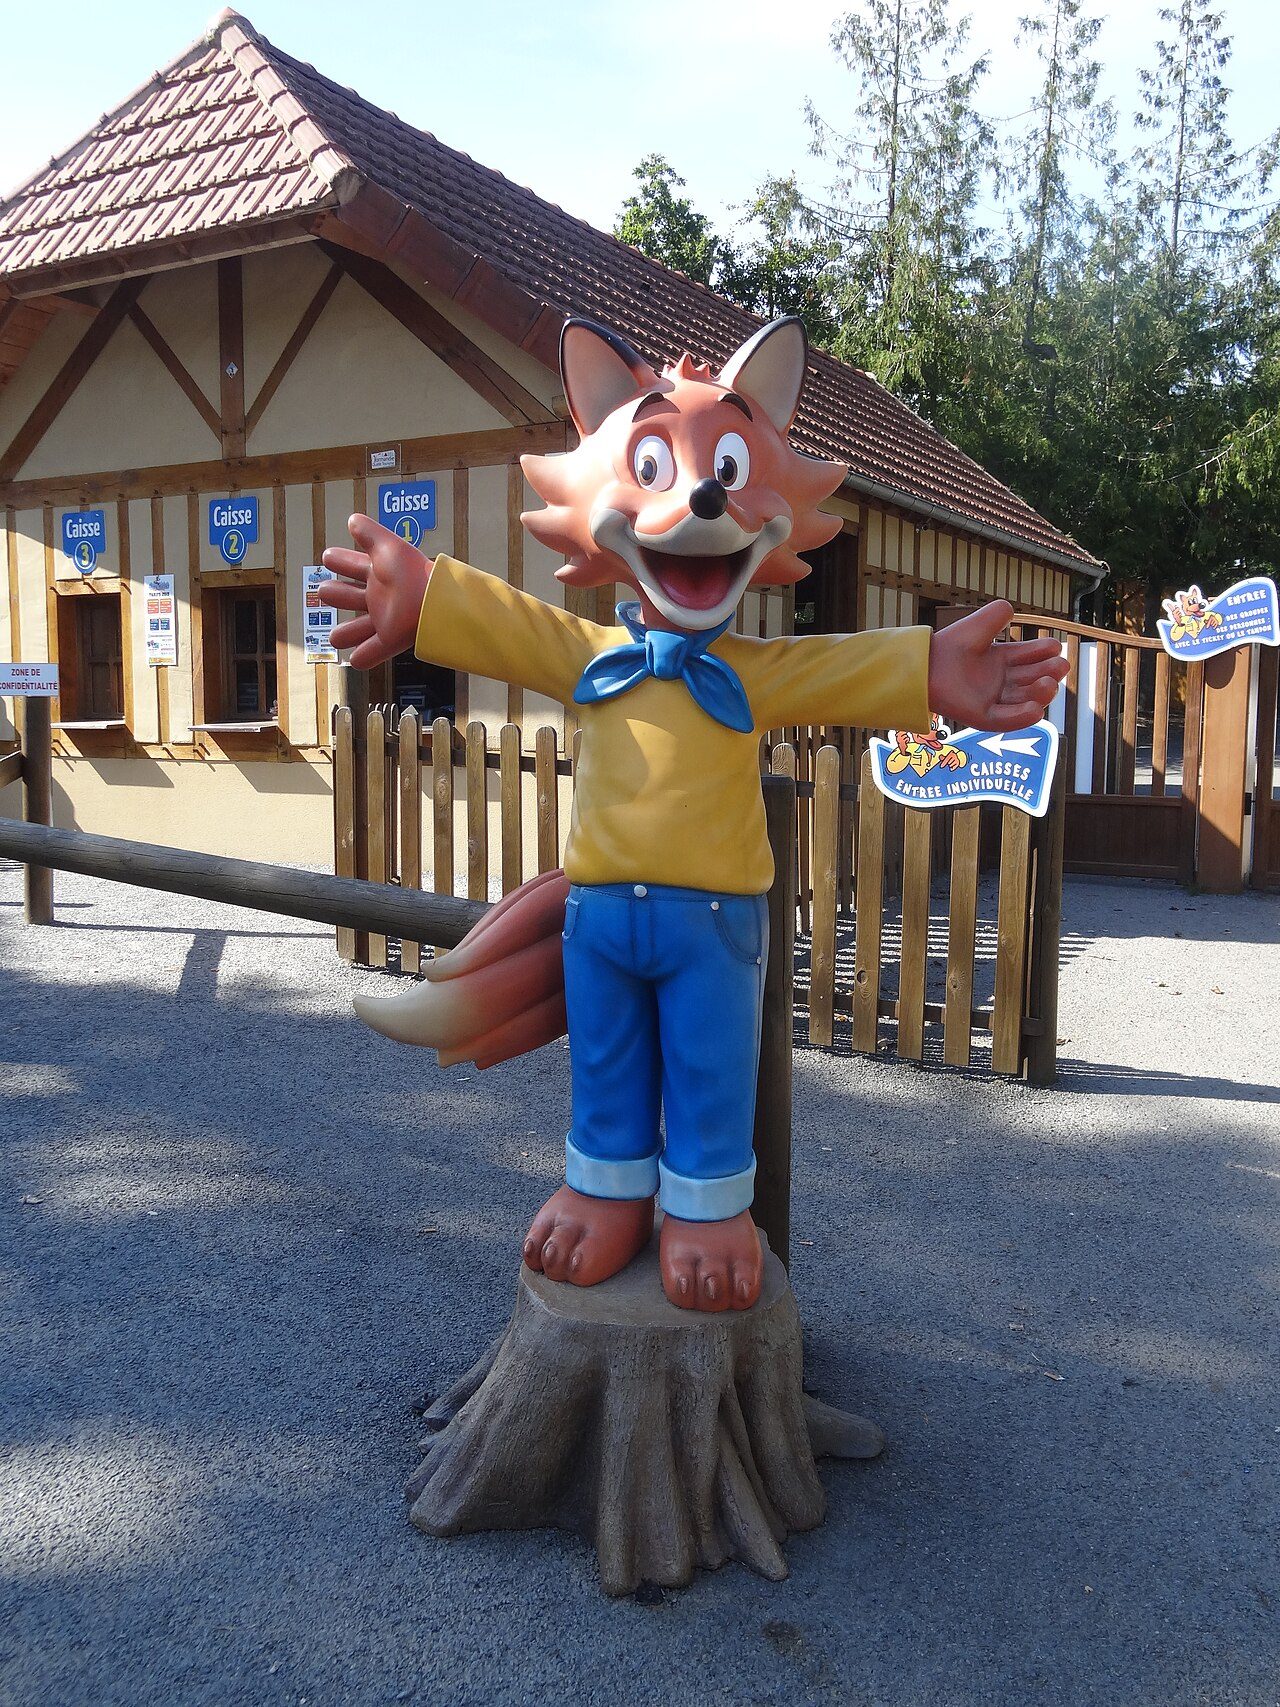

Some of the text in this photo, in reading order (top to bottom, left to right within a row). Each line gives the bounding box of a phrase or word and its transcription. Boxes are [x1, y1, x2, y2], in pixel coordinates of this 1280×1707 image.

[383, 489, 429, 513] Caisse
[213, 505, 252, 527] Caisse
[66, 519, 100, 538] Caisse
[402, 520, 413, 542] 1
[229, 534, 239, 554] 2
[81, 544, 90, 566] 3
[1227, 590, 1266, 606] ENTREE
[1240, 607, 1269, 618] GROUPES
[1215, 626, 1228, 634] DES
[1229, 618, 1265, 631] PERSONNES
[1174, 624, 1272, 649] AVEC LE TICKET OU LE TAMPON
[11, 668, 40, 676] ZONE DE
[970, 761, 1031, 781] CAISSES
[895, 778, 1034, 801] ENTREE INDIVIDUELLE
